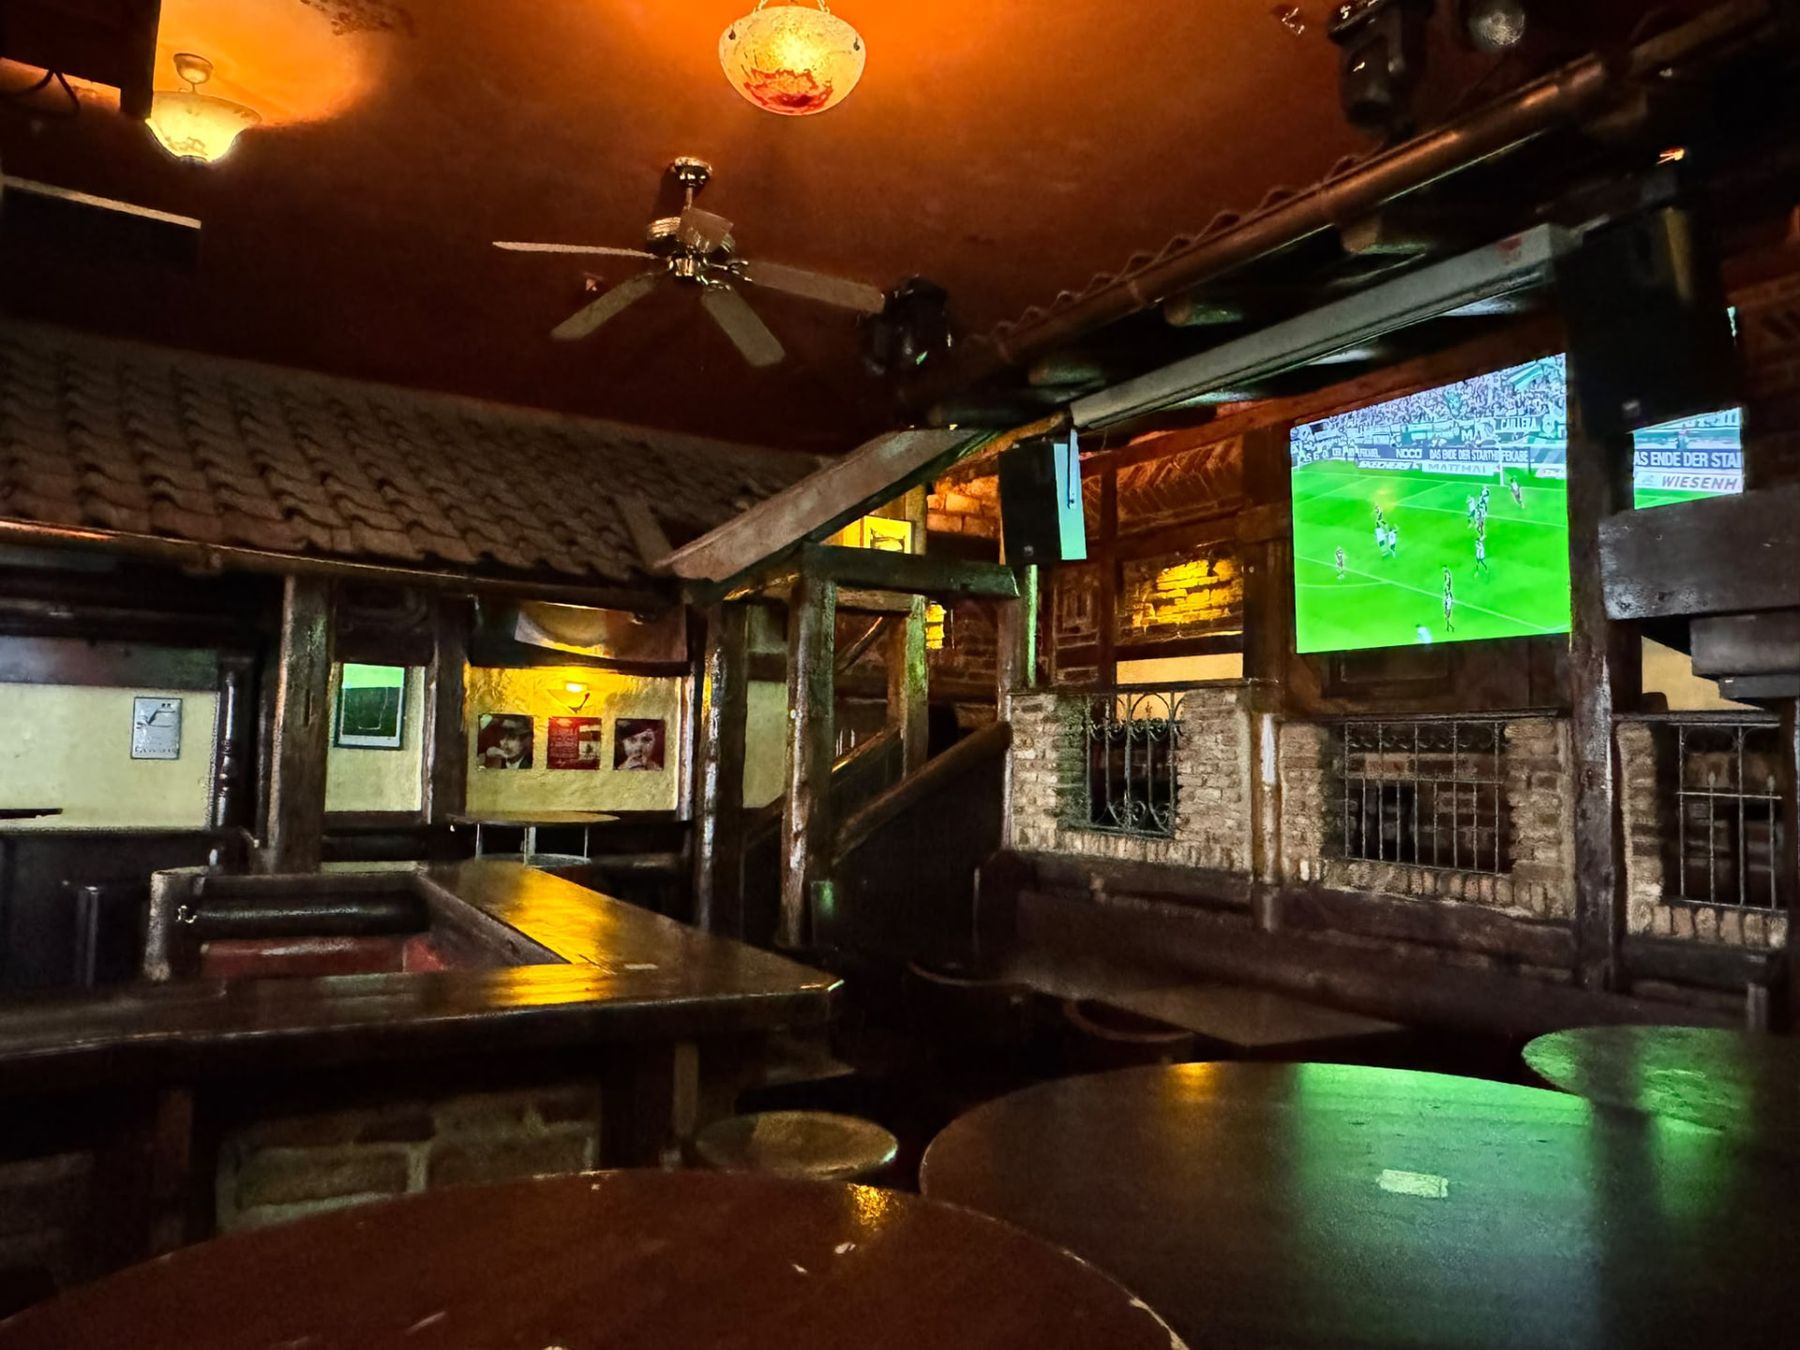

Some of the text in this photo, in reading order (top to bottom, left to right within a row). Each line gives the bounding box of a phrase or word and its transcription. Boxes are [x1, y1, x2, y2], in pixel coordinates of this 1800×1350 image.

[1650, 451, 1681, 467] ENDE
[1683, 452, 1708, 467] DER
[1662, 475, 1738, 490] WIESENH
